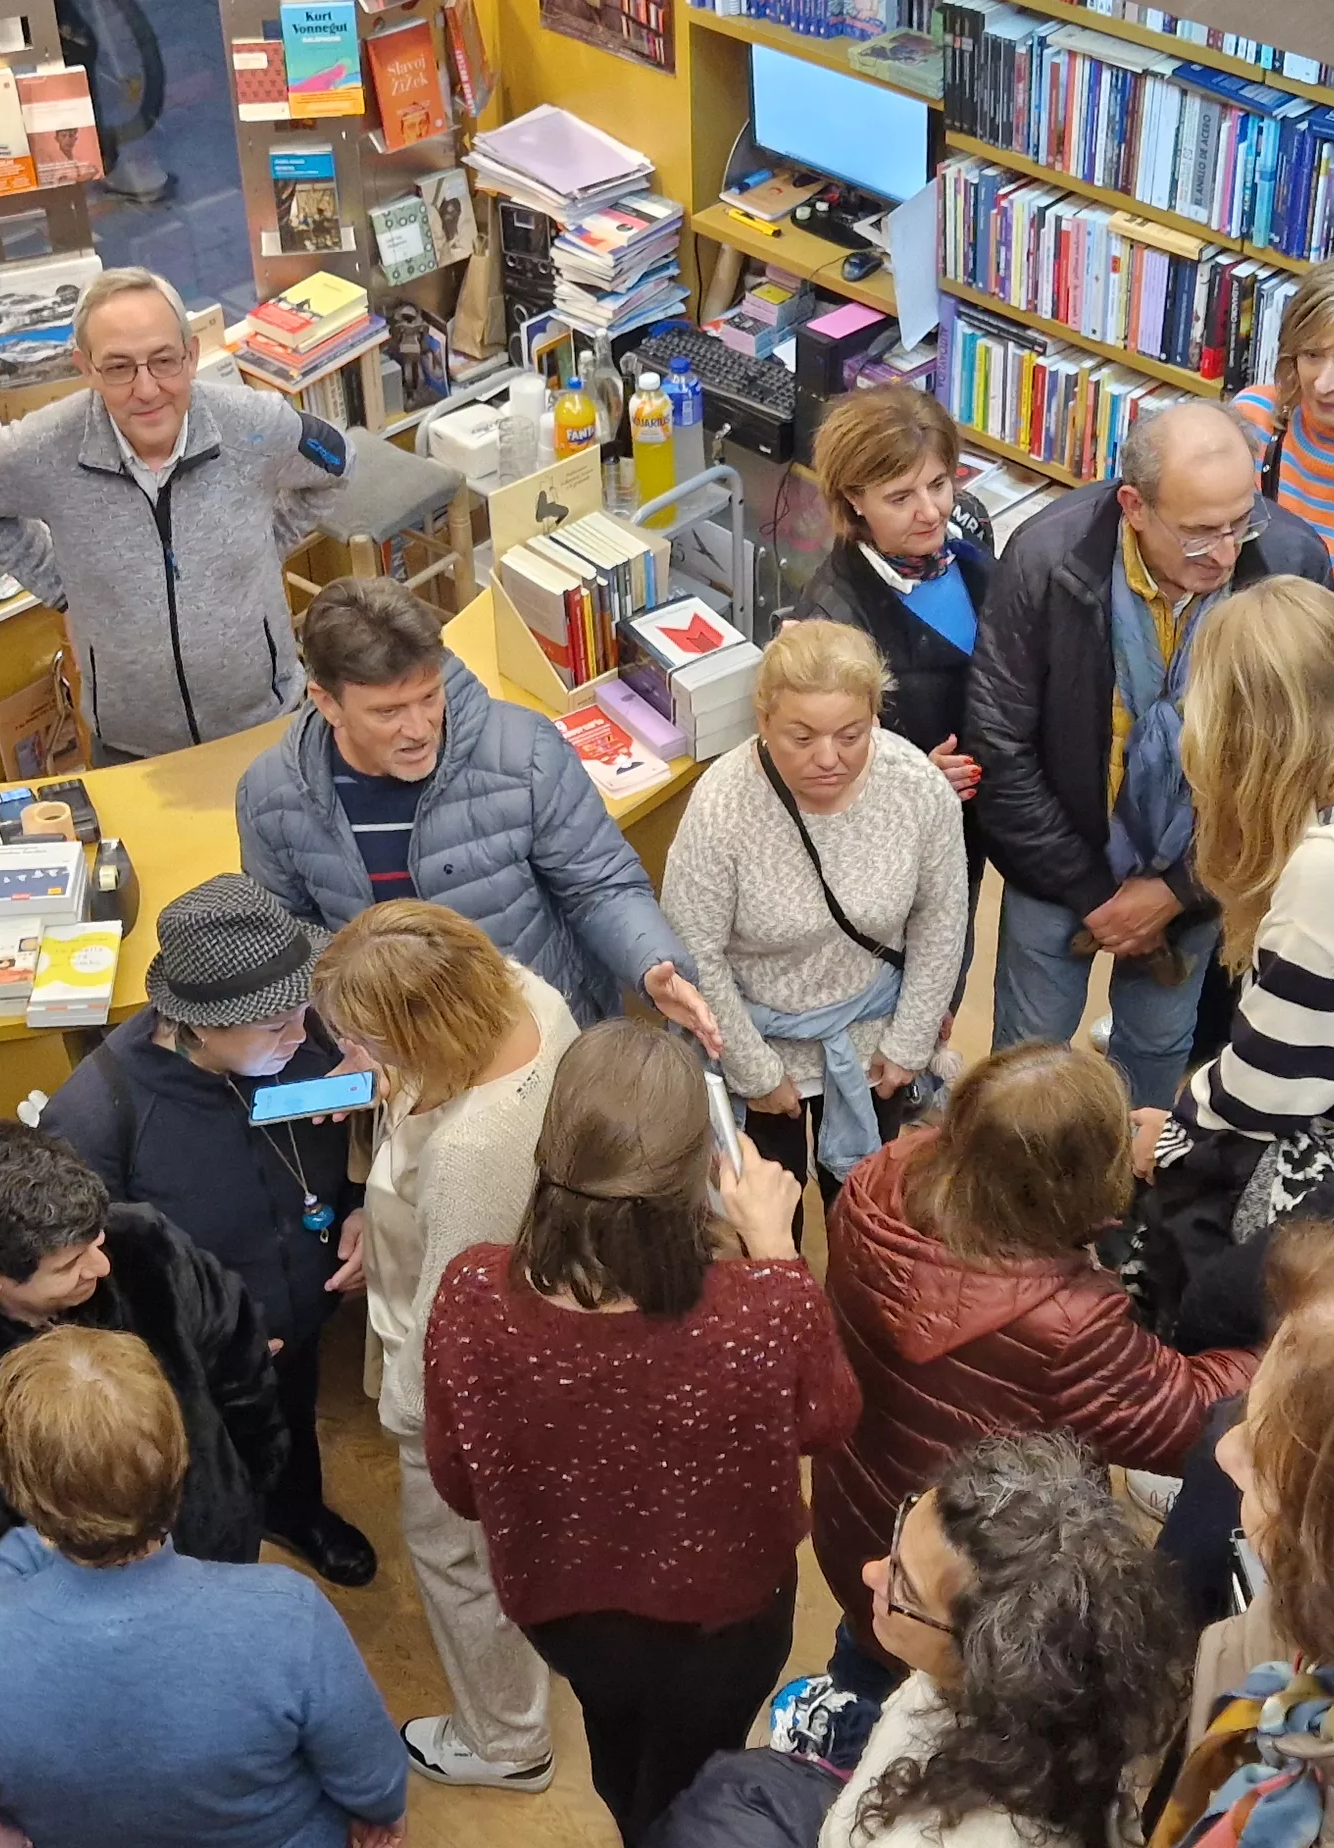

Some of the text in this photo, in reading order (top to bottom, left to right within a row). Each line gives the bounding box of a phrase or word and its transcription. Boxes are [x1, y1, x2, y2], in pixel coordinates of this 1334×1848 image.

[305, 11, 332, 22] Kurt
[292, 23, 348, 34] Vonnegut
[387, 53, 426, 75] Slavoj
[1200, 114, 1210, 144] ACERO
[1199, 148, 1207, 159] DE
[1195, 162, 1205, 193] ANILLO
